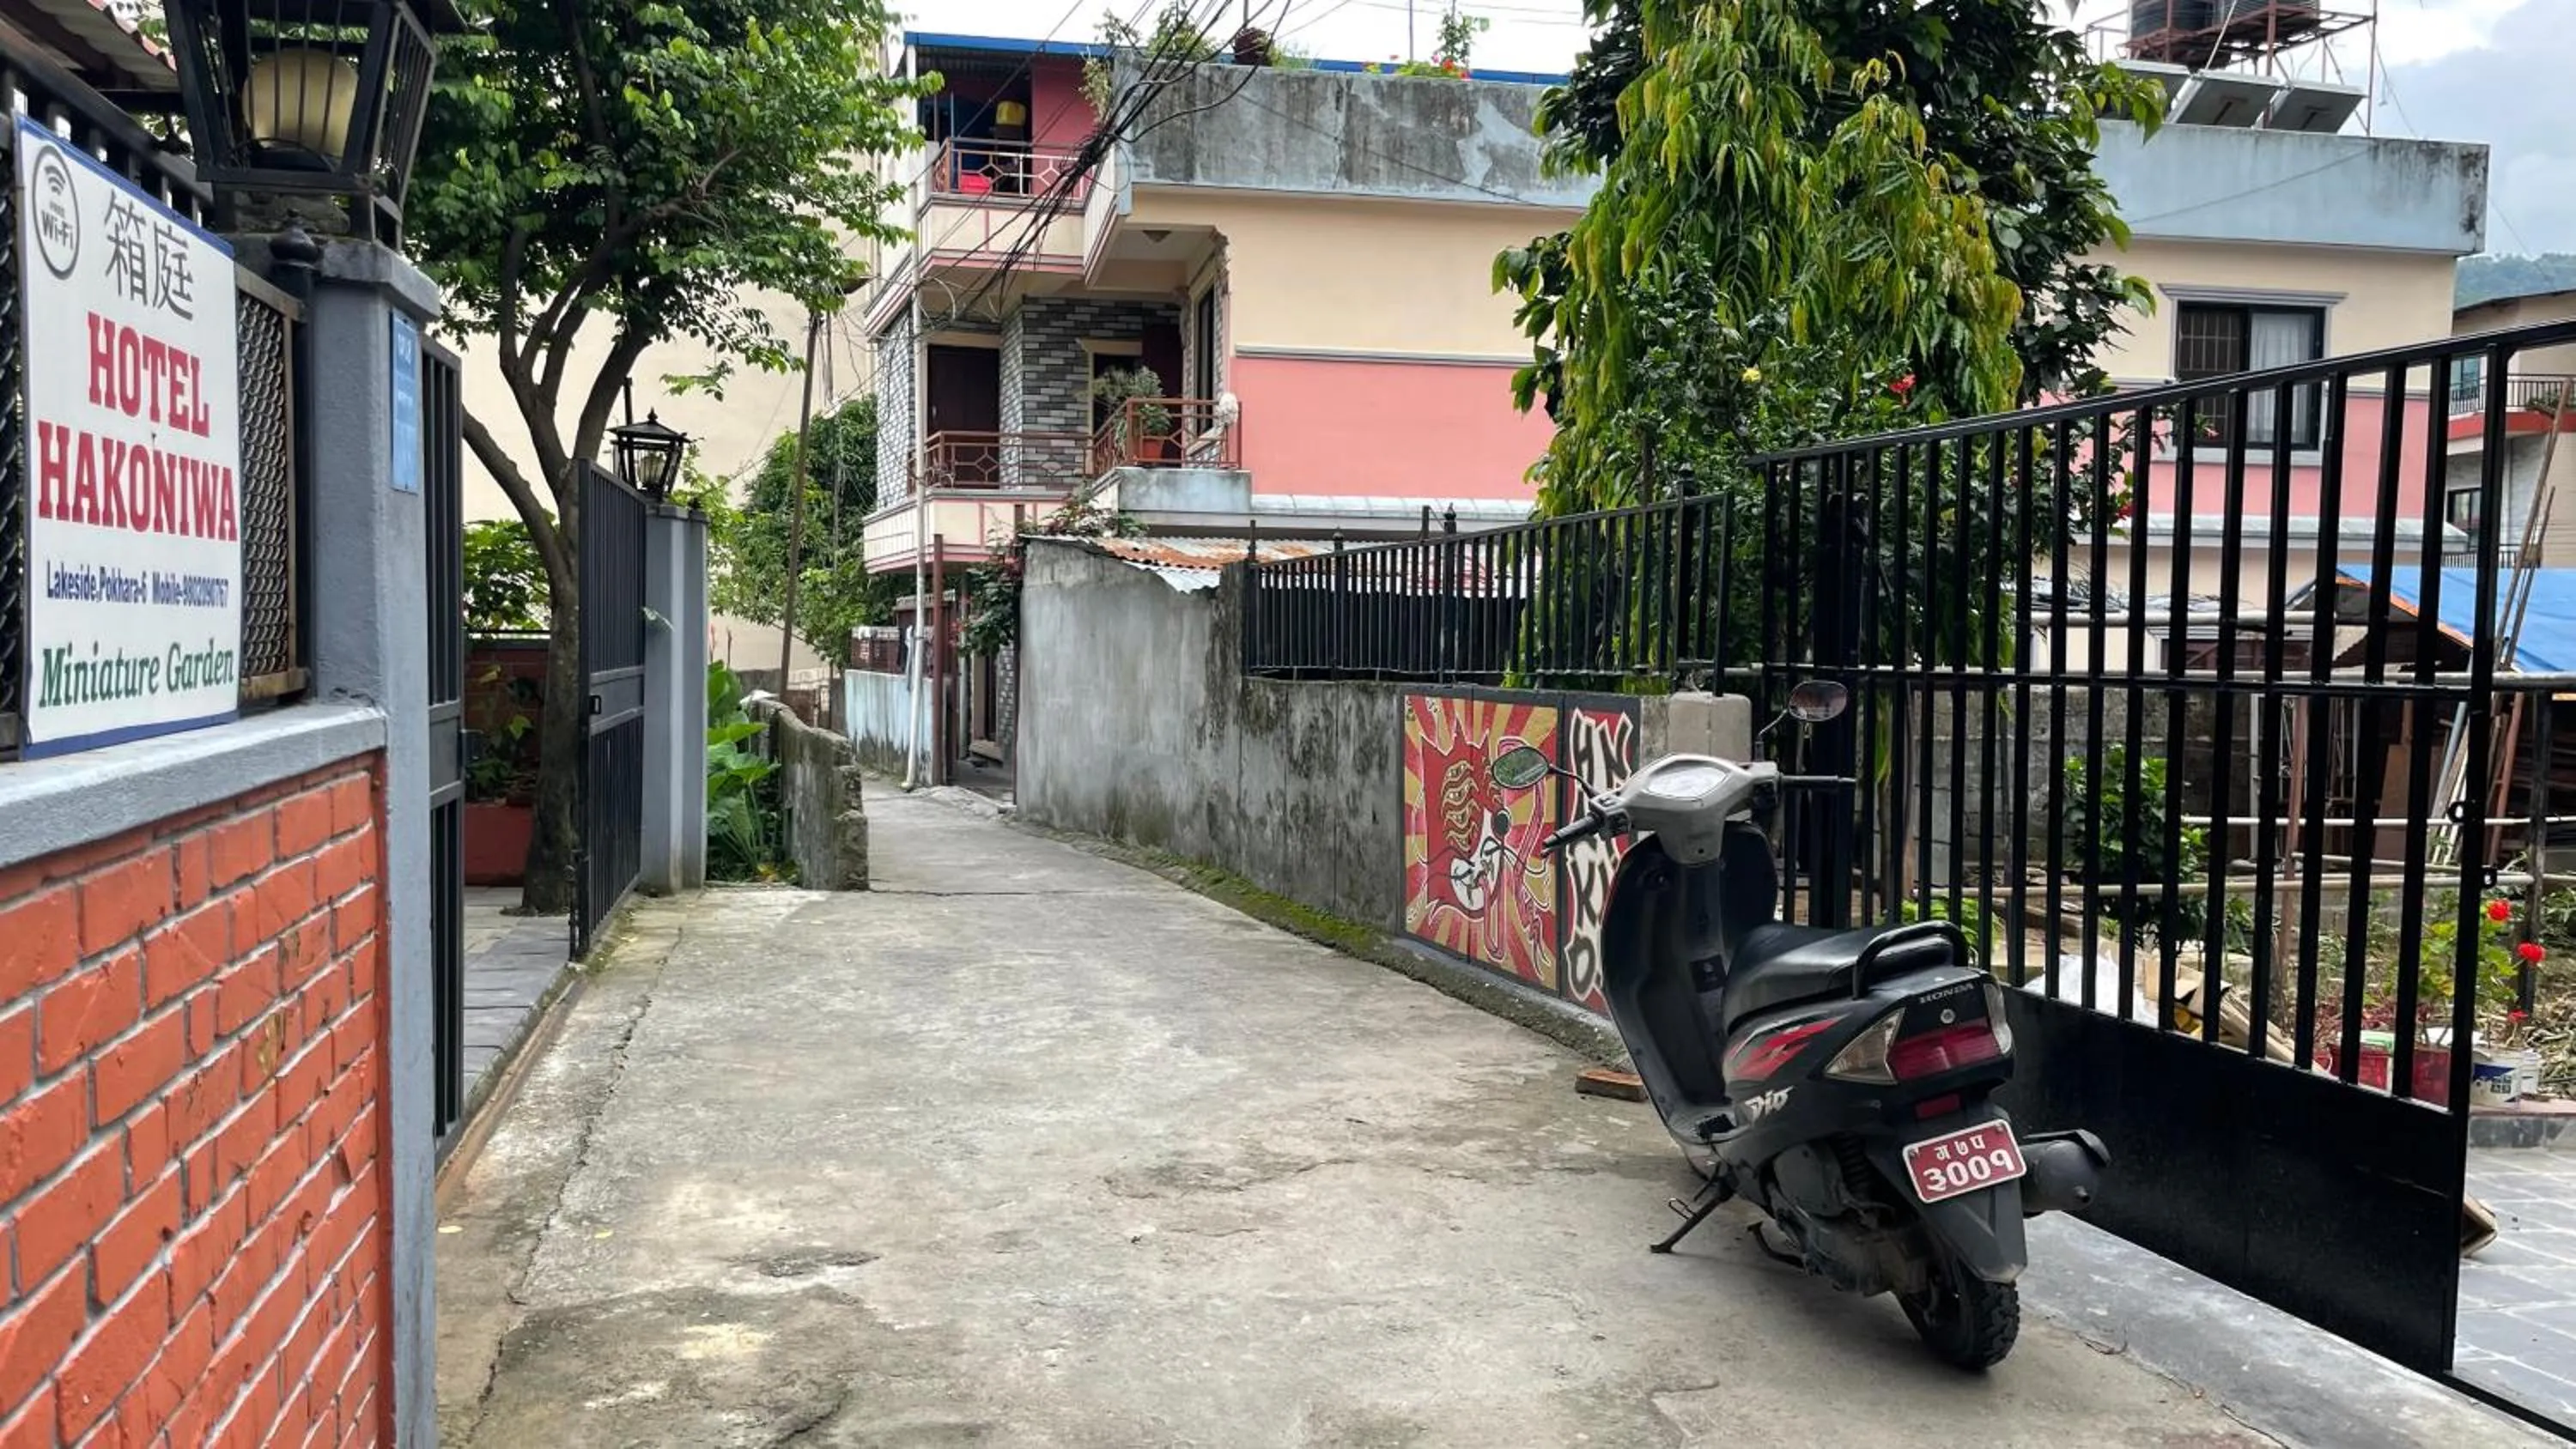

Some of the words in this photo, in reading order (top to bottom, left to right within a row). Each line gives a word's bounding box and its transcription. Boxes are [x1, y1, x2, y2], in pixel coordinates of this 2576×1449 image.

[41, 209, 74, 251] Wi-Fi
[104, 188, 194, 322] 箱庭
[88, 311, 210, 439] HOTEL
[38, 420, 238, 542] HAKONIWA
[39, 640, 161, 708] Miniature
[166, 638, 234, 694] Garden
[1919, 982, 1974, 1004] HONDA
